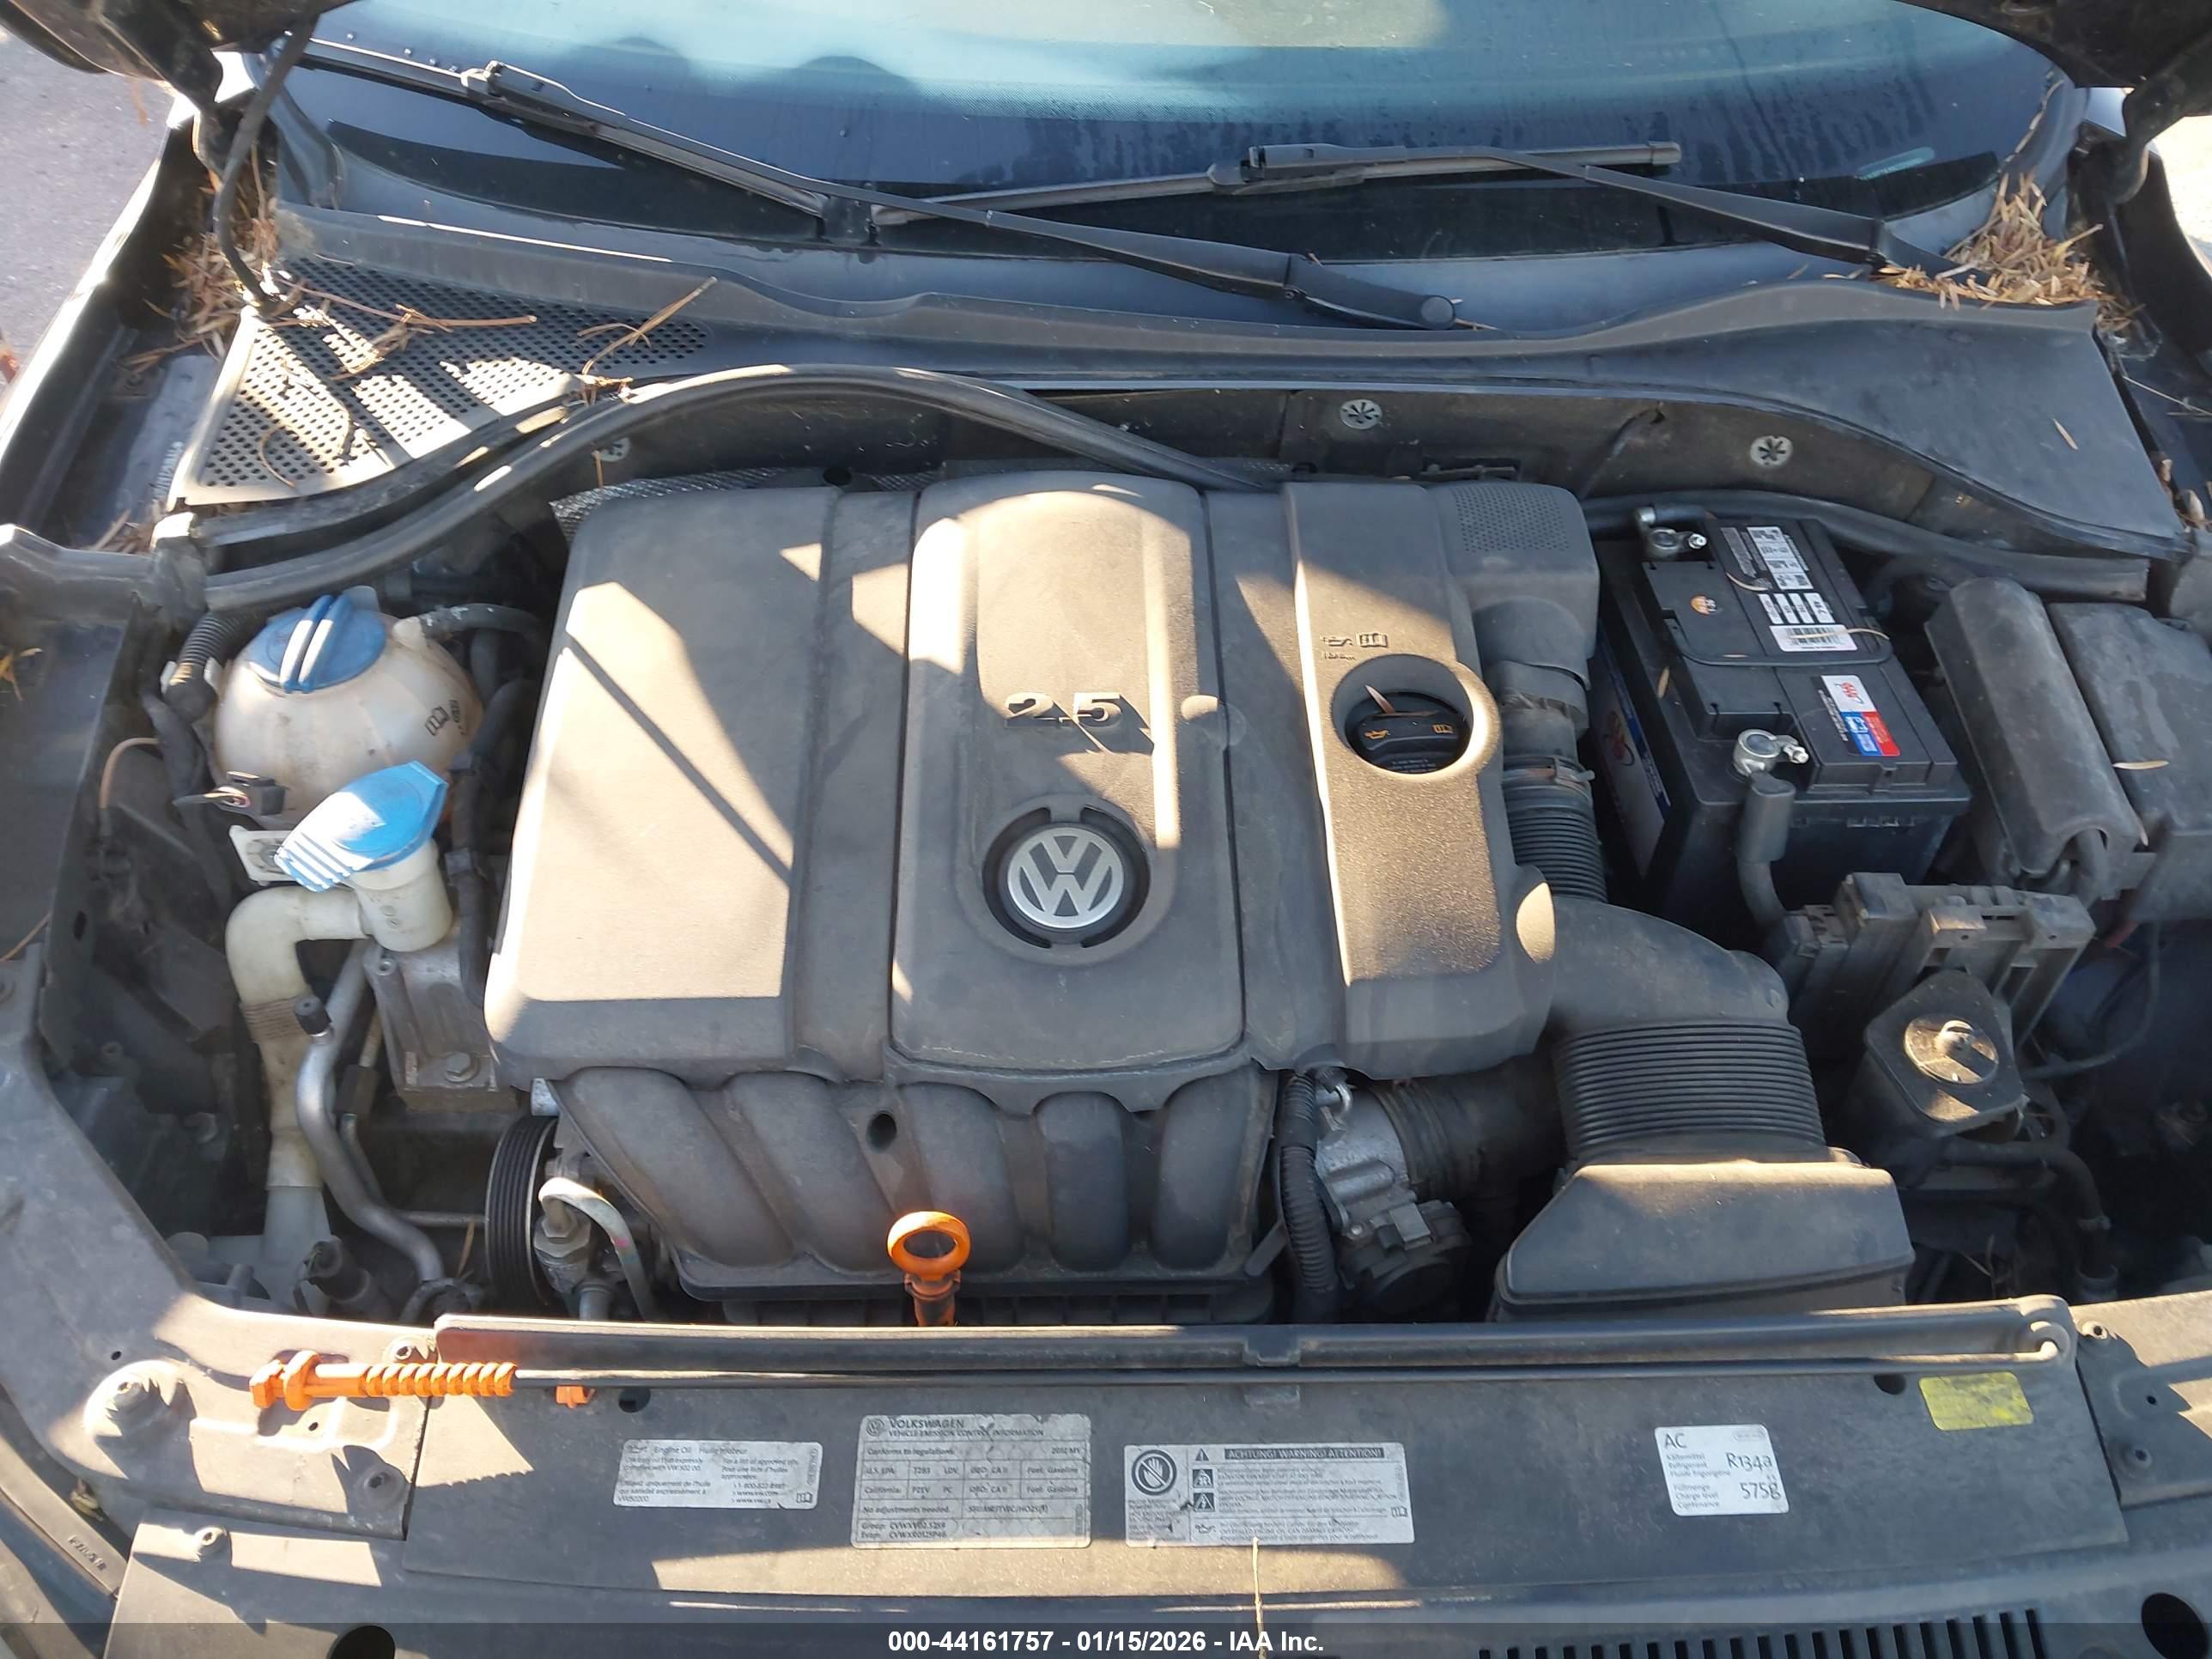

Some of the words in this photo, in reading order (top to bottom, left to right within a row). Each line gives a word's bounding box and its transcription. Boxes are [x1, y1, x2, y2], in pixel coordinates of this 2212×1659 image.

[1004, 691, 1122, 728] 2.5
[1010, 829, 1123, 927] VW
[890, 1419, 964, 1429] VOLKSWAGEN
[1665, 1432, 1687, 1449] AC
[1228, 1449, 1277, 1459] ACHTUNG!
[1279, 1449, 1327, 1459] WARNING!
[1328, 1449, 1382, 1458] ATTENTION!
[1725, 1452, 1772, 1472] R134a
[1739, 1482, 1781, 1500] 575g
